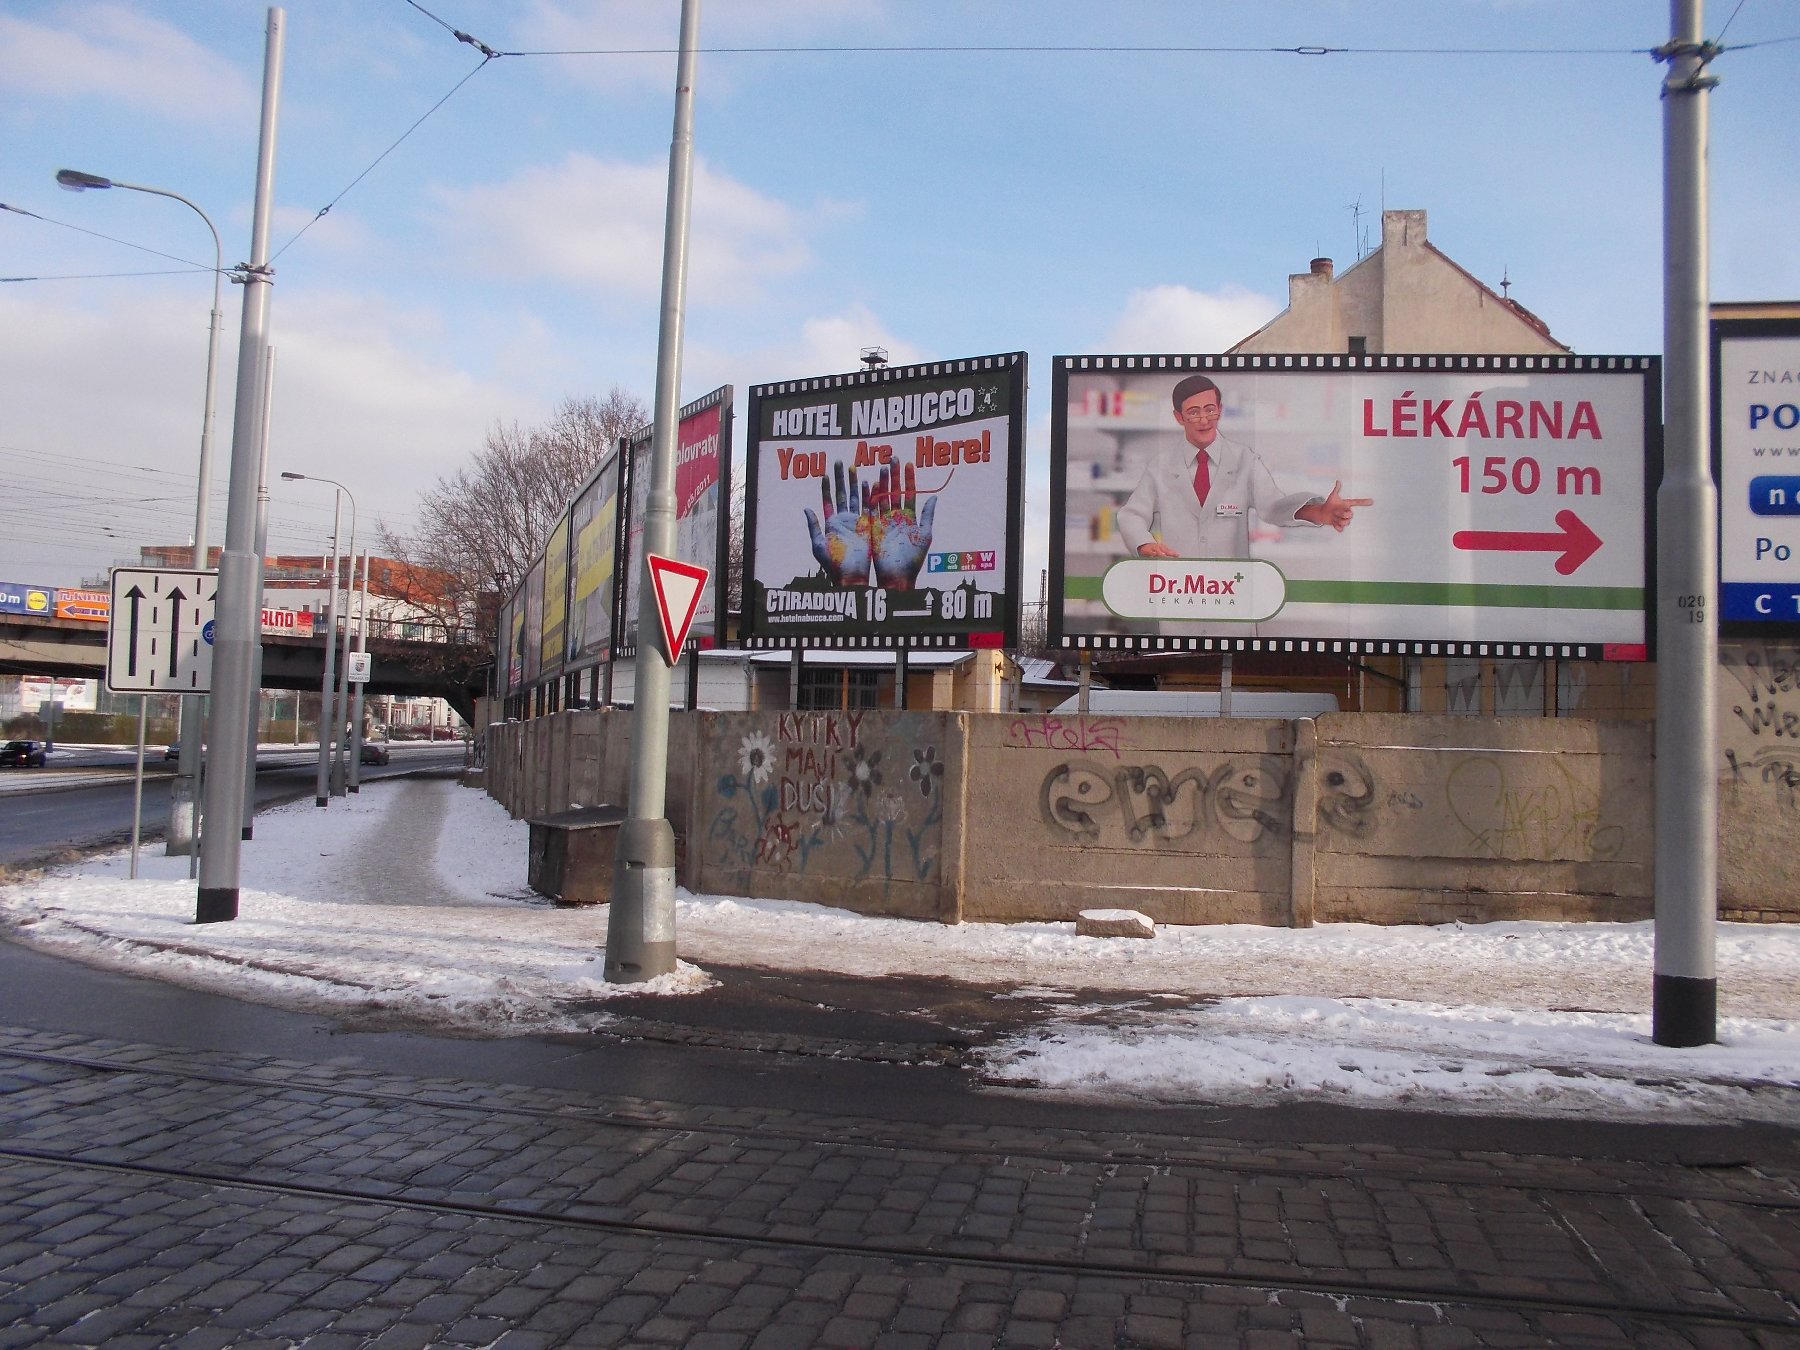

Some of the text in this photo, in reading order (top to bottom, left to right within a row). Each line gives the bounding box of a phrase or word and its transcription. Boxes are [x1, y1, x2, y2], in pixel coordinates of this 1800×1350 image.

[1748, 371, 1800, 384] ZNA
[773, 387, 975, 437] HOTEL NABUCCO
[1363, 390, 1603, 440] LÉKÁRNA
[1749, 404, 1800, 430] PO
[777, 429, 991, 481] You Are Here!
[1452, 456, 1602, 495] 150 m
[1769, 488, 1800, 506] n
[1756, 537, 1791, 562] Po
[930, 555, 942, 571] P
[1149, 573, 1235, 595] Dr.Max
[766, 588, 992, 622] CTIRADOVA 16 80 m
[1148, 596, 1236, 605] LÉKÁRNA
[768, 613, 844, 623] www.hotelnabucco.com
[1689, 610, 1704, 623] 19
[778, 711, 865, 750] KYTKY
[785, 747, 843, 780] MAJÍ
